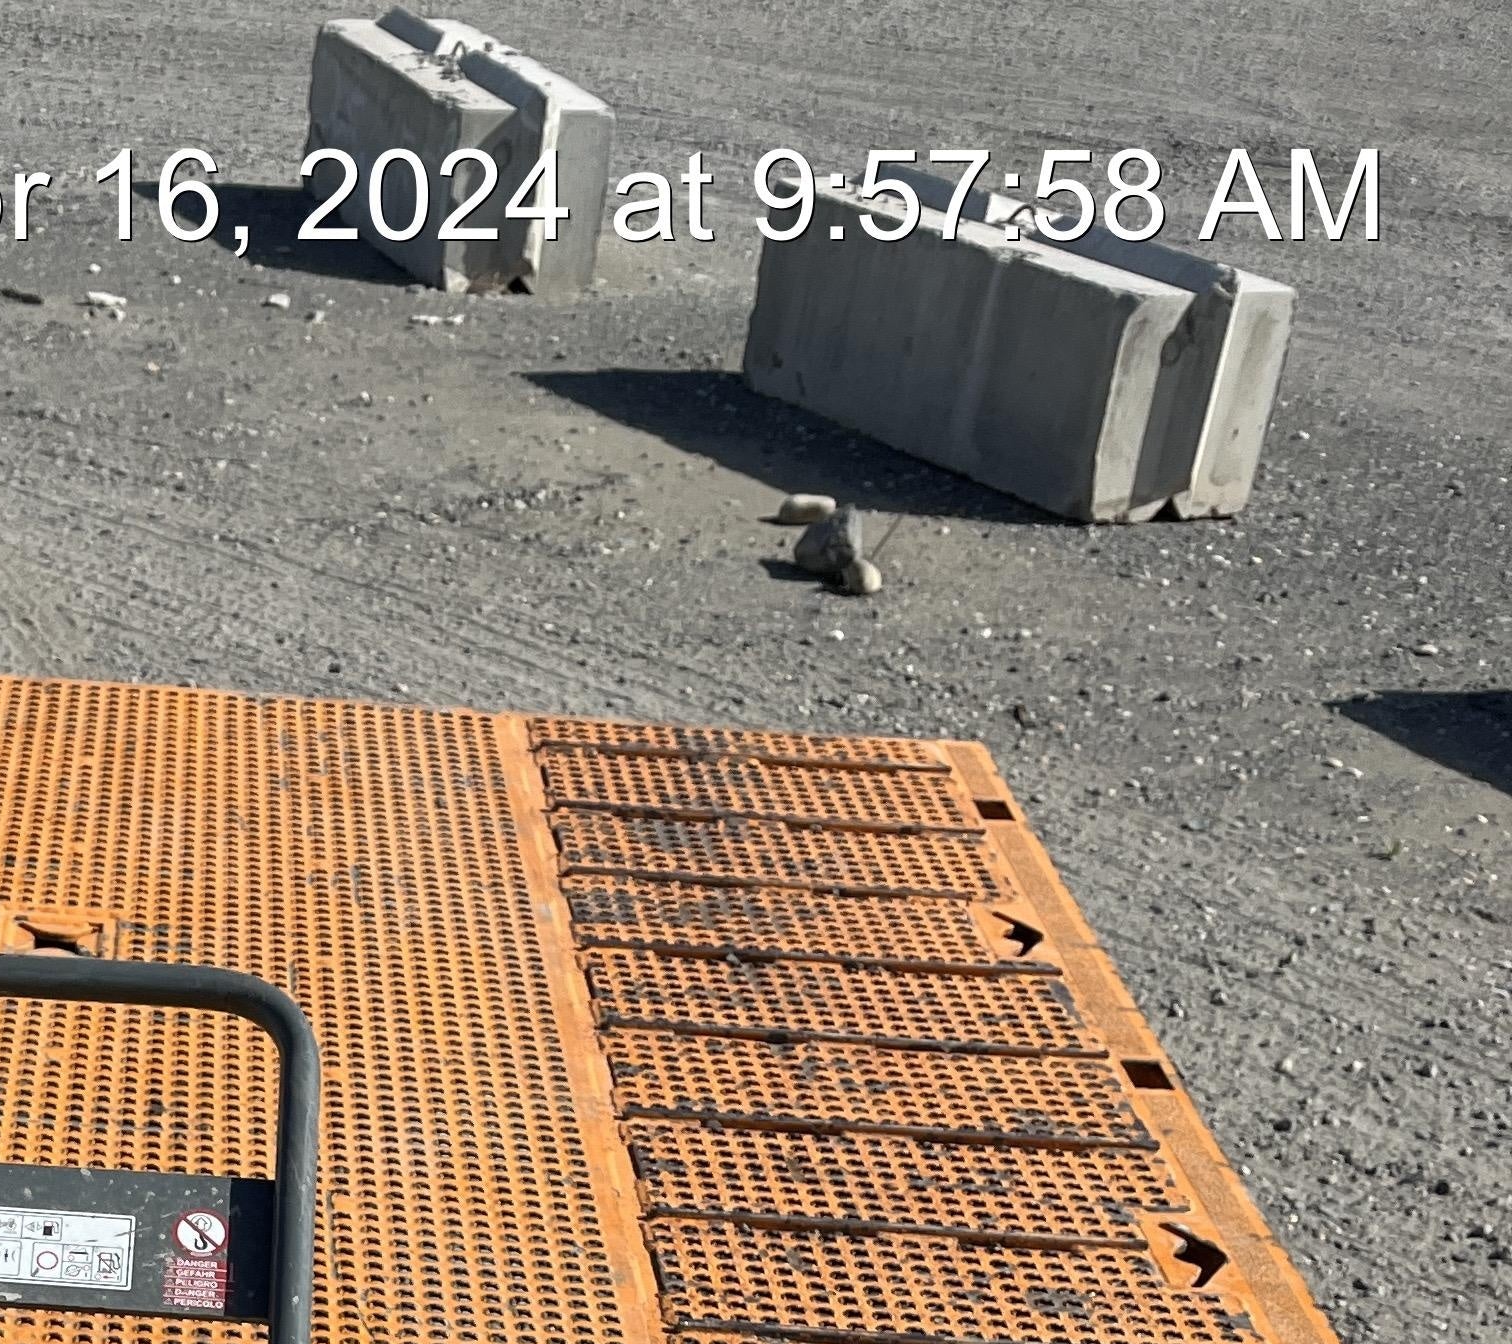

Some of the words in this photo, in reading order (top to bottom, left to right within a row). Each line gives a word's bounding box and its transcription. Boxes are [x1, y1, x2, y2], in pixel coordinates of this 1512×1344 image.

[176, 1257, 218, 1269] DANGER
[175, 1268, 216, 1279] GEFAHR
[175, 1278, 219, 1289] PELIGRO
[174, 1288, 216, 1298] DANGER
[173, 1297, 224, 1309] PERICOLO
